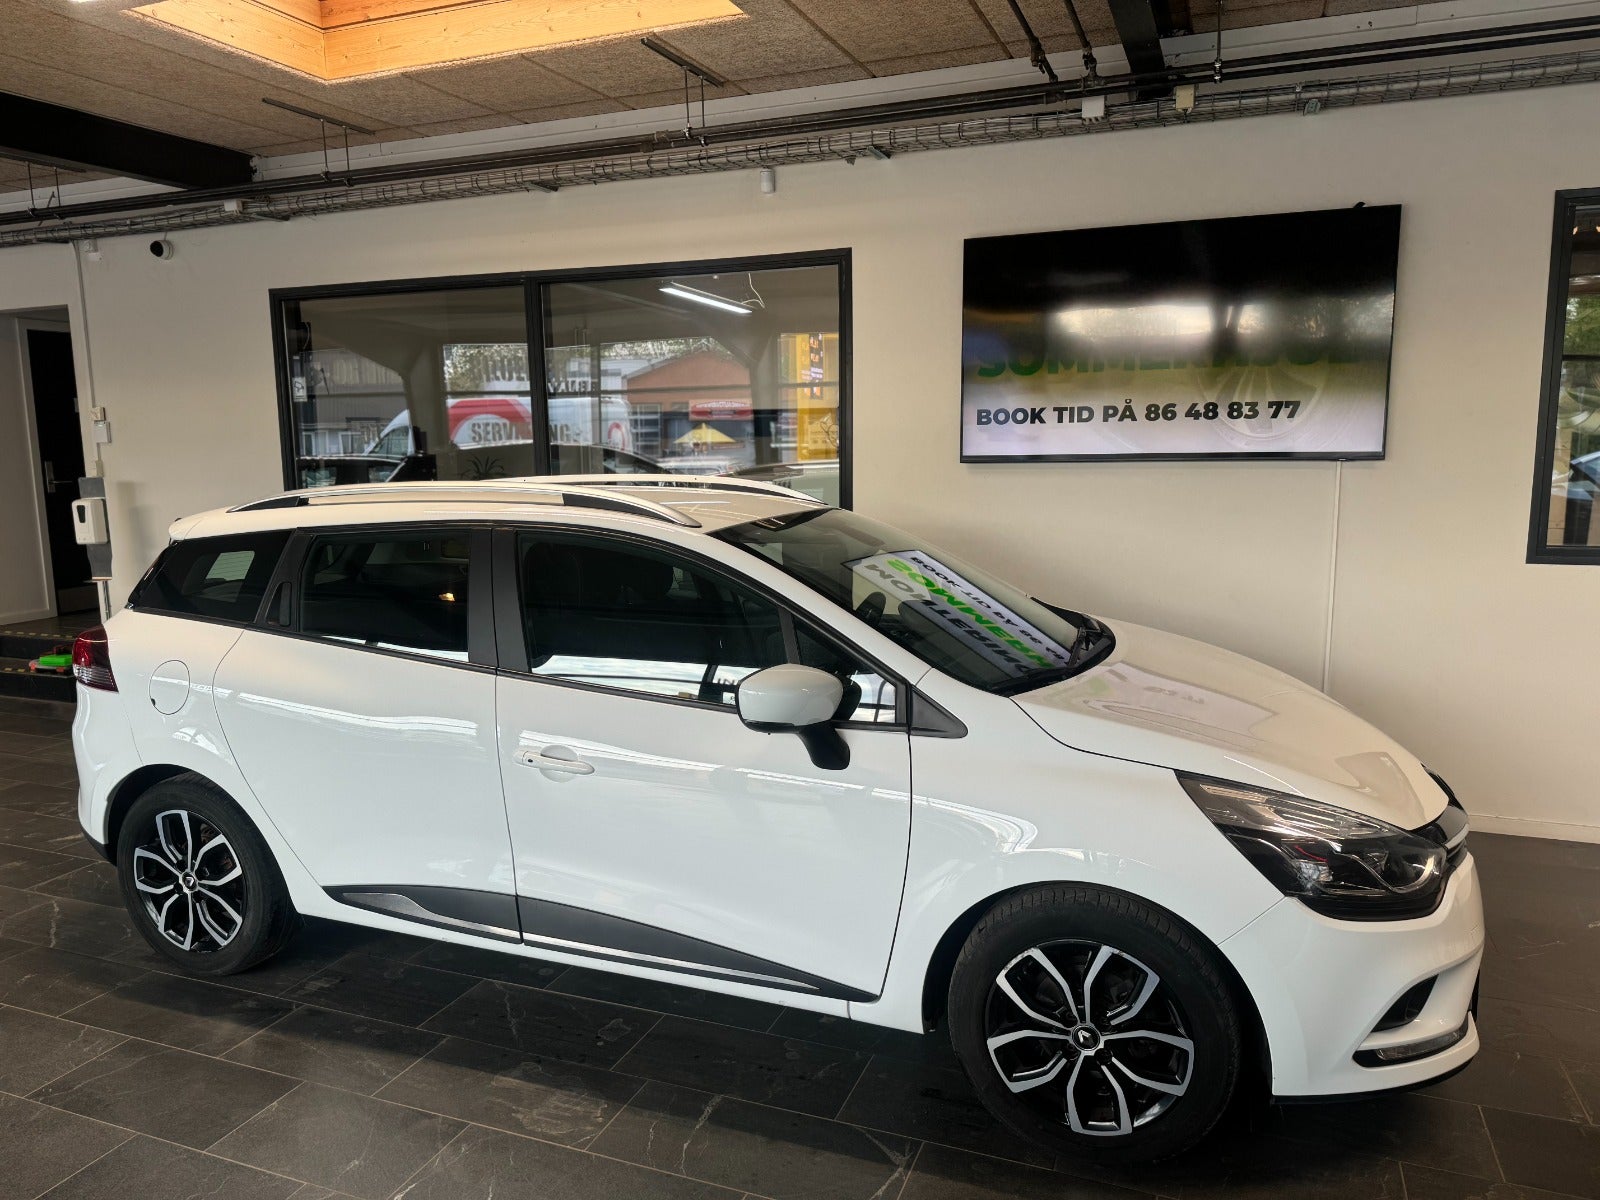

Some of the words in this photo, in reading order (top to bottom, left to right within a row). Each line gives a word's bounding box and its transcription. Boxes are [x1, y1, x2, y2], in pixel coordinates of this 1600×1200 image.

[976, 407, 1047, 426] BOOK
[1053, 405, 1095, 424] TID
[1102, 398, 1138, 423] PÅ
[1144, 402, 1178, 422] 86
[1184, 402, 1219, 421] 48
[1226, 401, 1260, 420] 83
[1267, 400, 1301, 419] 77
